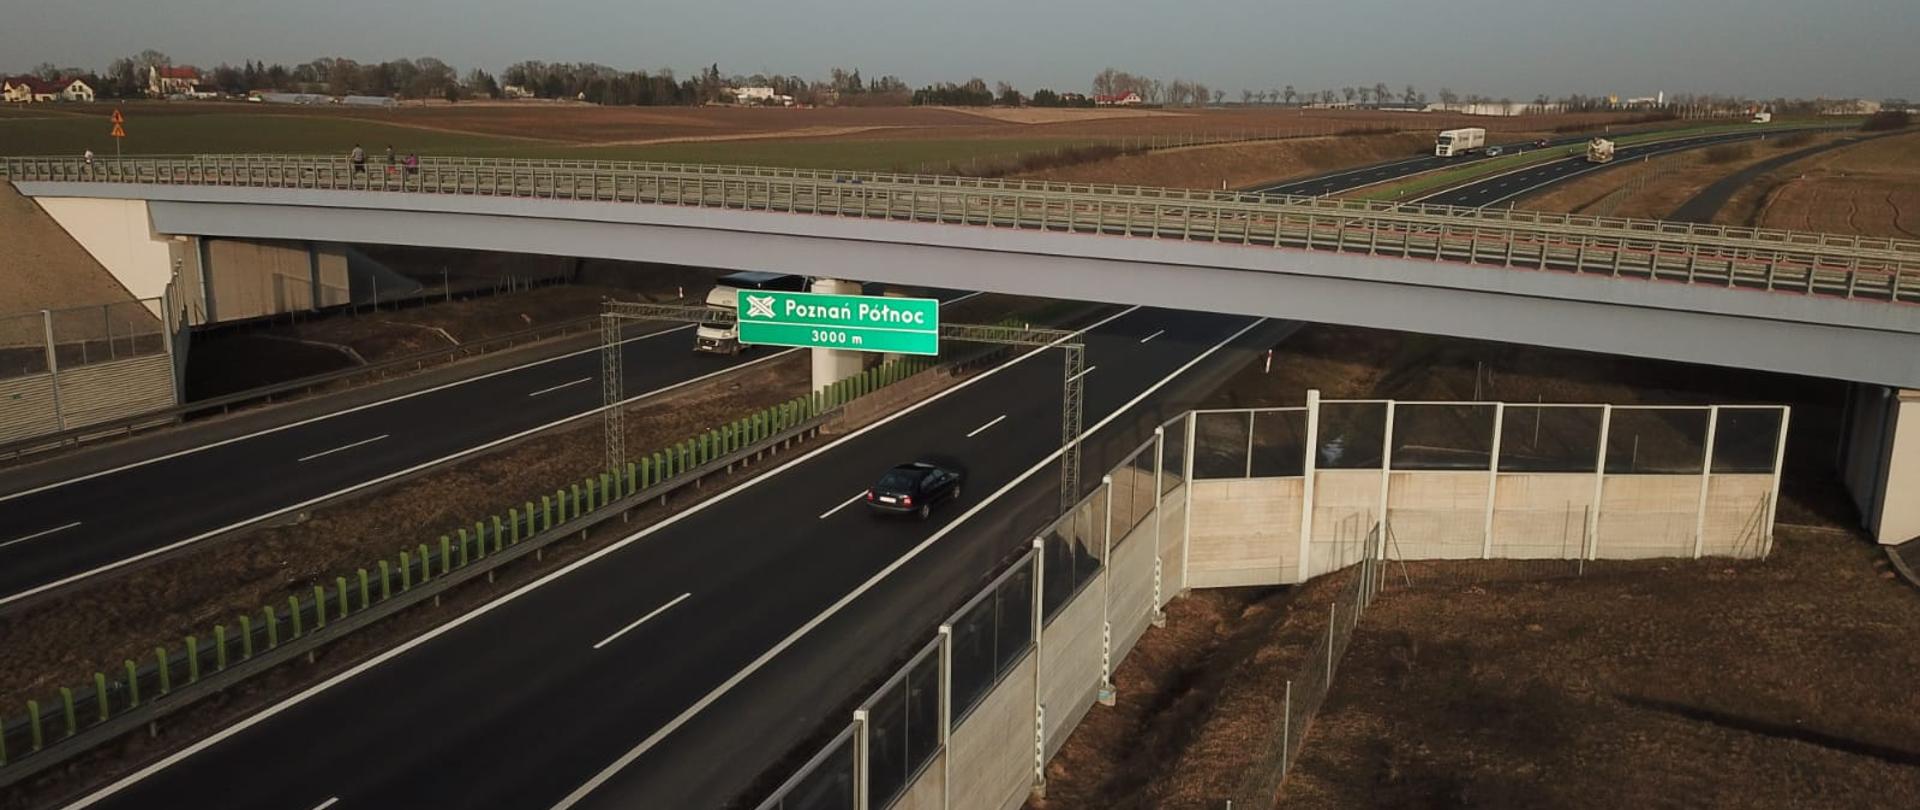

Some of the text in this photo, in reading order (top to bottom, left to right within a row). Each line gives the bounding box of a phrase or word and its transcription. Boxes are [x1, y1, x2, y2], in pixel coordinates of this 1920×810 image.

[785, 299, 925, 324] Poznań Północ
[811, 330, 863, 345] 3000 m
